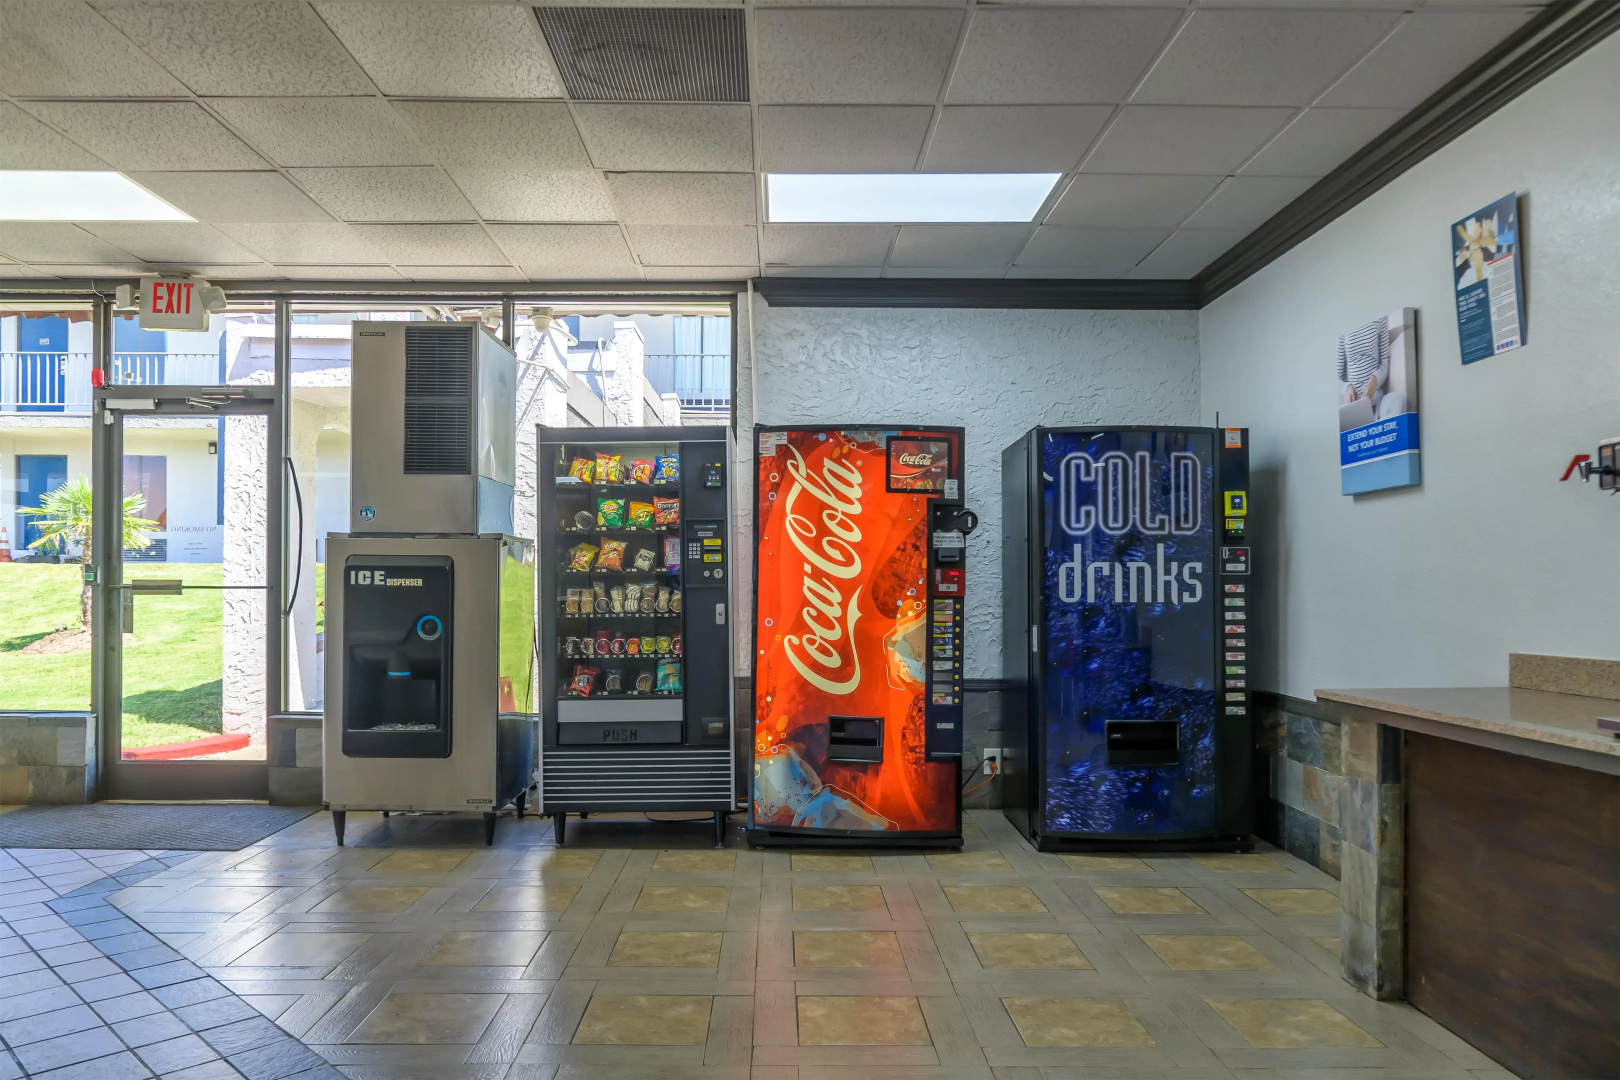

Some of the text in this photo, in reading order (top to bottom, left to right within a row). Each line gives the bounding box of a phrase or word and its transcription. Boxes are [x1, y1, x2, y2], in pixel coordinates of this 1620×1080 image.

[152, 282, 194, 314] EXIT
[1347, 420, 1398, 442] EXTEND YOUR STAY,
[1348, 442, 1359, 453] NOT
[1360, 438, 1374, 449] YOUR
[1374, 432, 1397, 446] BUDGET
[1060, 451, 1201, 535] COLD
[350, 570, 423, 587] ICE DISPENSER
[783, 443, 863, 695] Coca-Cola
[1058, 543, 1203, 605] drinks
[603, 728, 637, 742] PUSH
